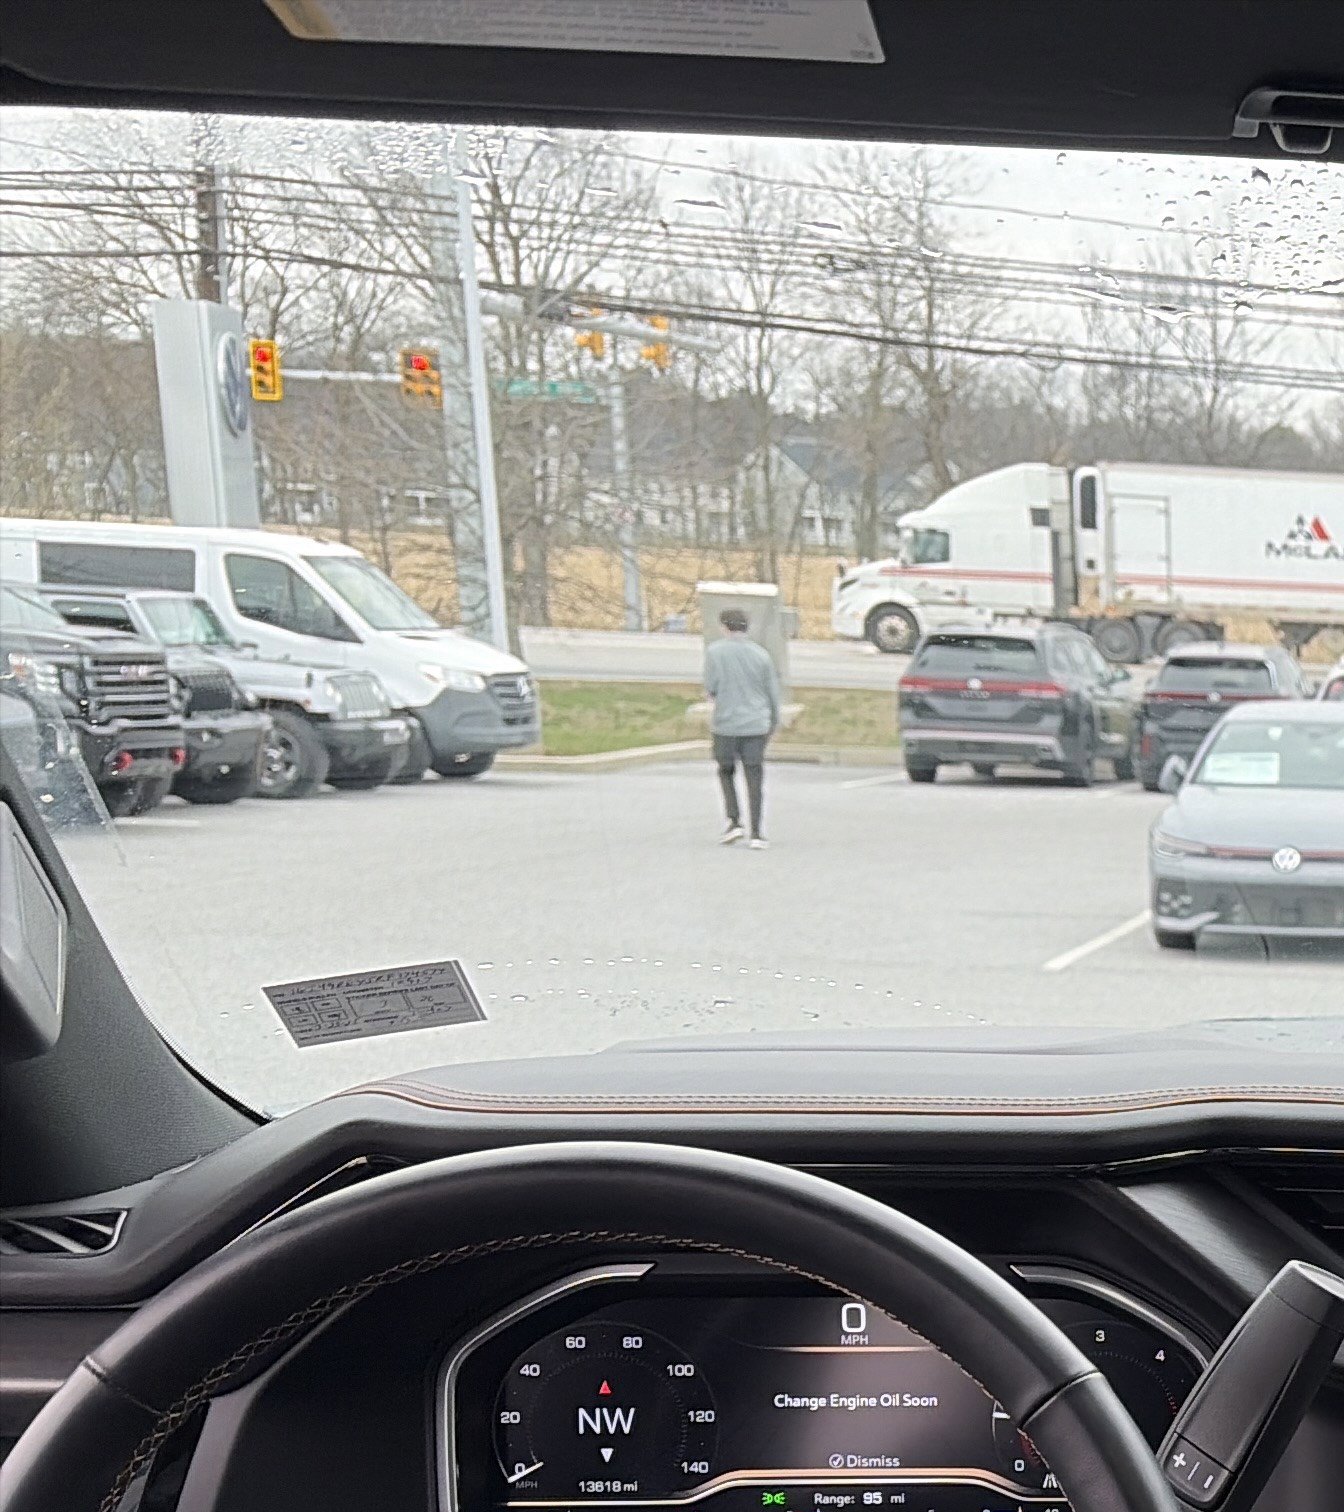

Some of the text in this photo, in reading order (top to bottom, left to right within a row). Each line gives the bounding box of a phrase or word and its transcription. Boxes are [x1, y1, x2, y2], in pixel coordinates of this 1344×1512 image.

[841, 1303, 866, 1332] 0
[841, 1335, 868, 1345] MPH
[1095, 1330, 1105, 1342] 3
[566, 1337, 585, 1349] 60
[623, 1337, 642, 1349] 80
[1155, 1350, 1165, 1361] 4
[520, 1365, 540, 1376] 40
[667, 1365, 694, 1376] 100
[774, 1394, 937, 1410] Change Engine Oil Soon
[501, 1412, 520, 1424] 20
[578, 1408, 635, 1434] NW
[688, 1411, 714, 1422] 120
[847, 1455, 900, 1467] Dismiss
[1015, 1460, 1024, 1472] 0
[681, 1462, 709, 1473] 140
[623, 1480, 638, 1492] mi
[814, 1492, 905, 1507] Range: 95 mi
